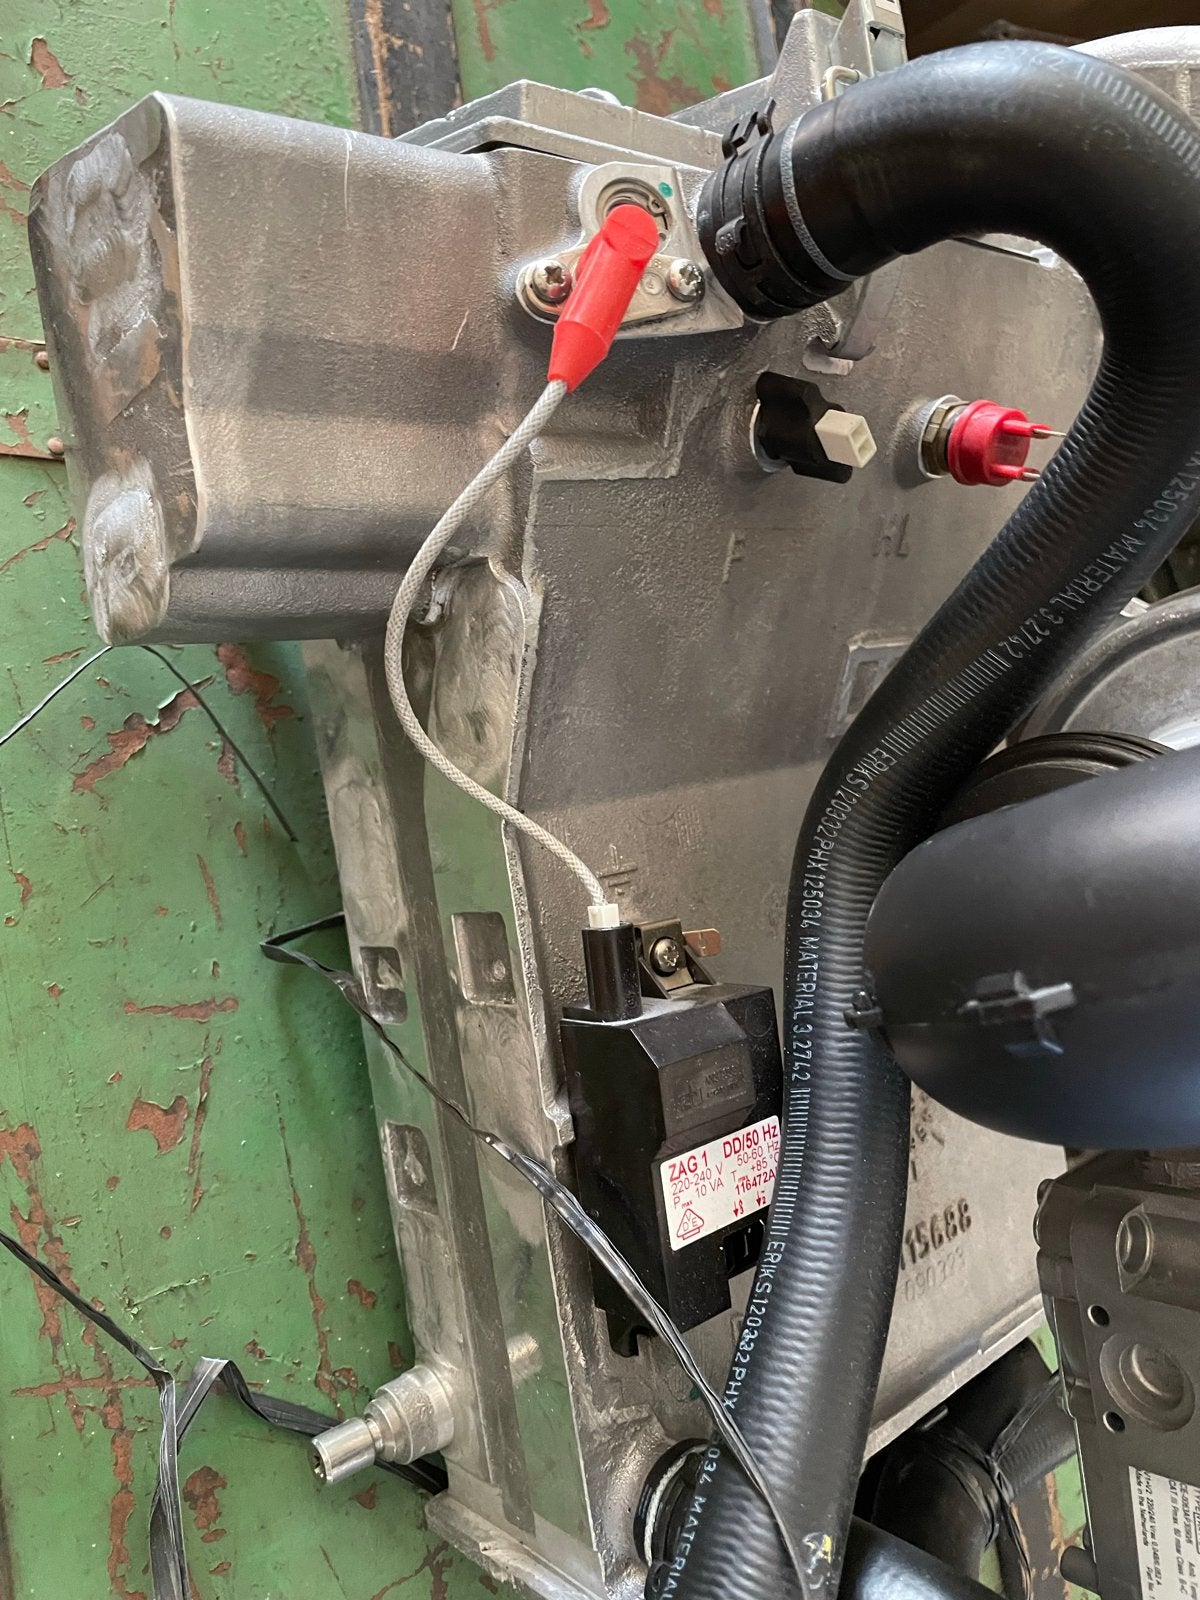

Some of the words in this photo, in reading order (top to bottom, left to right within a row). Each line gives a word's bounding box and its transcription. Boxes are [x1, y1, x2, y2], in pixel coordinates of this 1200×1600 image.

[1049, 533, 1146, 611] MATERIAL
[792, 936, 820, 1020] MATERIAL
[791, 1024, 813, 1081] 3.2742
[668, 1155, 698, 1182] ZAG
[701, 1150, 708, 1167] 1
[722, 1129, 759, 1159] DD/50
[762, 1123, 779, 1141] Hz
[671, 1167, 712, 1196] 220-240
[715, 1162, 723, 1175] V
[737, 1145, 763, 1166] 50-60
[767, 1141, 780, 1154] Hz
[696, 1184, 707, 1198] 10
[709, 1177, 724, 1192] VA
[750, 1157, 768, 1173] +85
[1168, 1479, 1178, 1495] CAT
